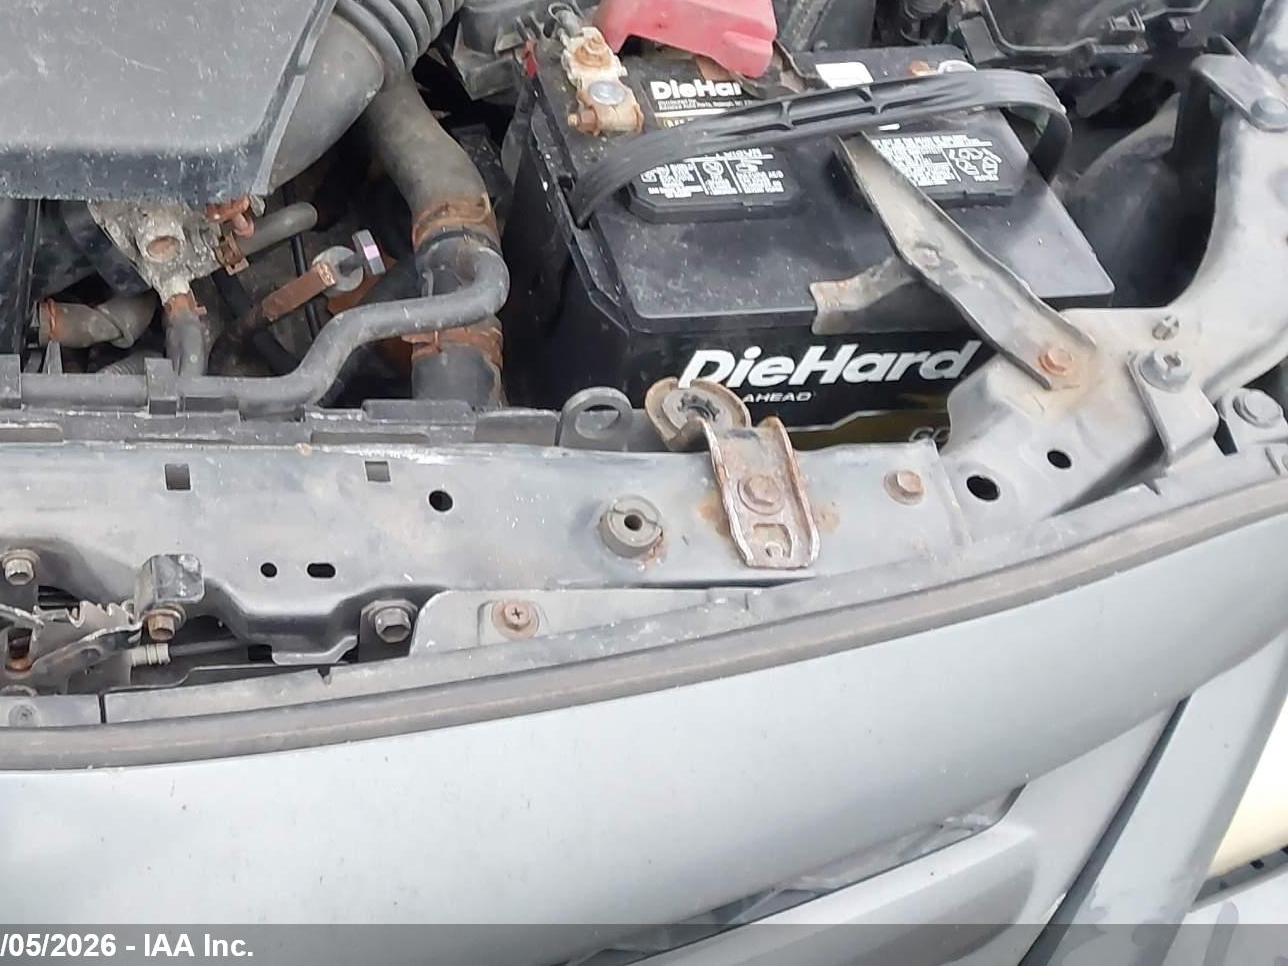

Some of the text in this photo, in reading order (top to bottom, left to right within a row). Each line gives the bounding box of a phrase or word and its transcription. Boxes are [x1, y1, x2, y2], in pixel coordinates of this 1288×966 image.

[650, 78, 744, 100] DieHar
[678, 340, 983, 389] DieHard
[743, 391, 813, 403] AHEAD
